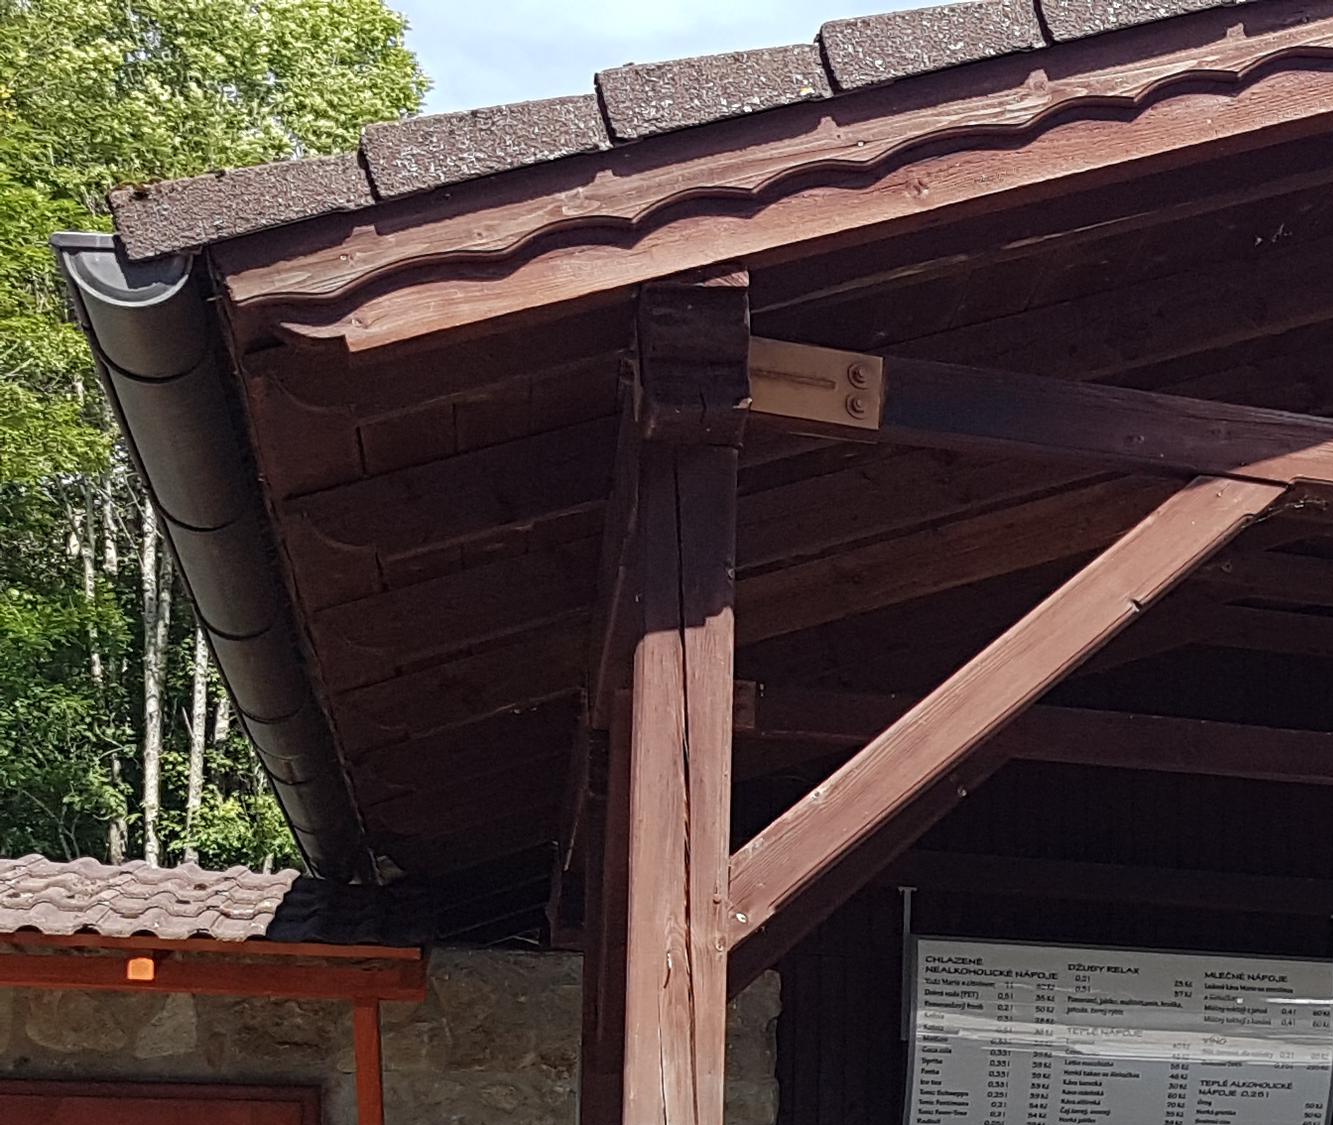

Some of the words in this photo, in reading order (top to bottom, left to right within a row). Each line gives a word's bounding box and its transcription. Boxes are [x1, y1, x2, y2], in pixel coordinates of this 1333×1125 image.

[925, 966, 1013, 978] NEALKOHOLICKÉ
[1015, 971, 1058, 980] NÁPOJE
[1106, 965, 1140, 975] RELAX
[1247, 974, 1288, 983] NÁPOJE
